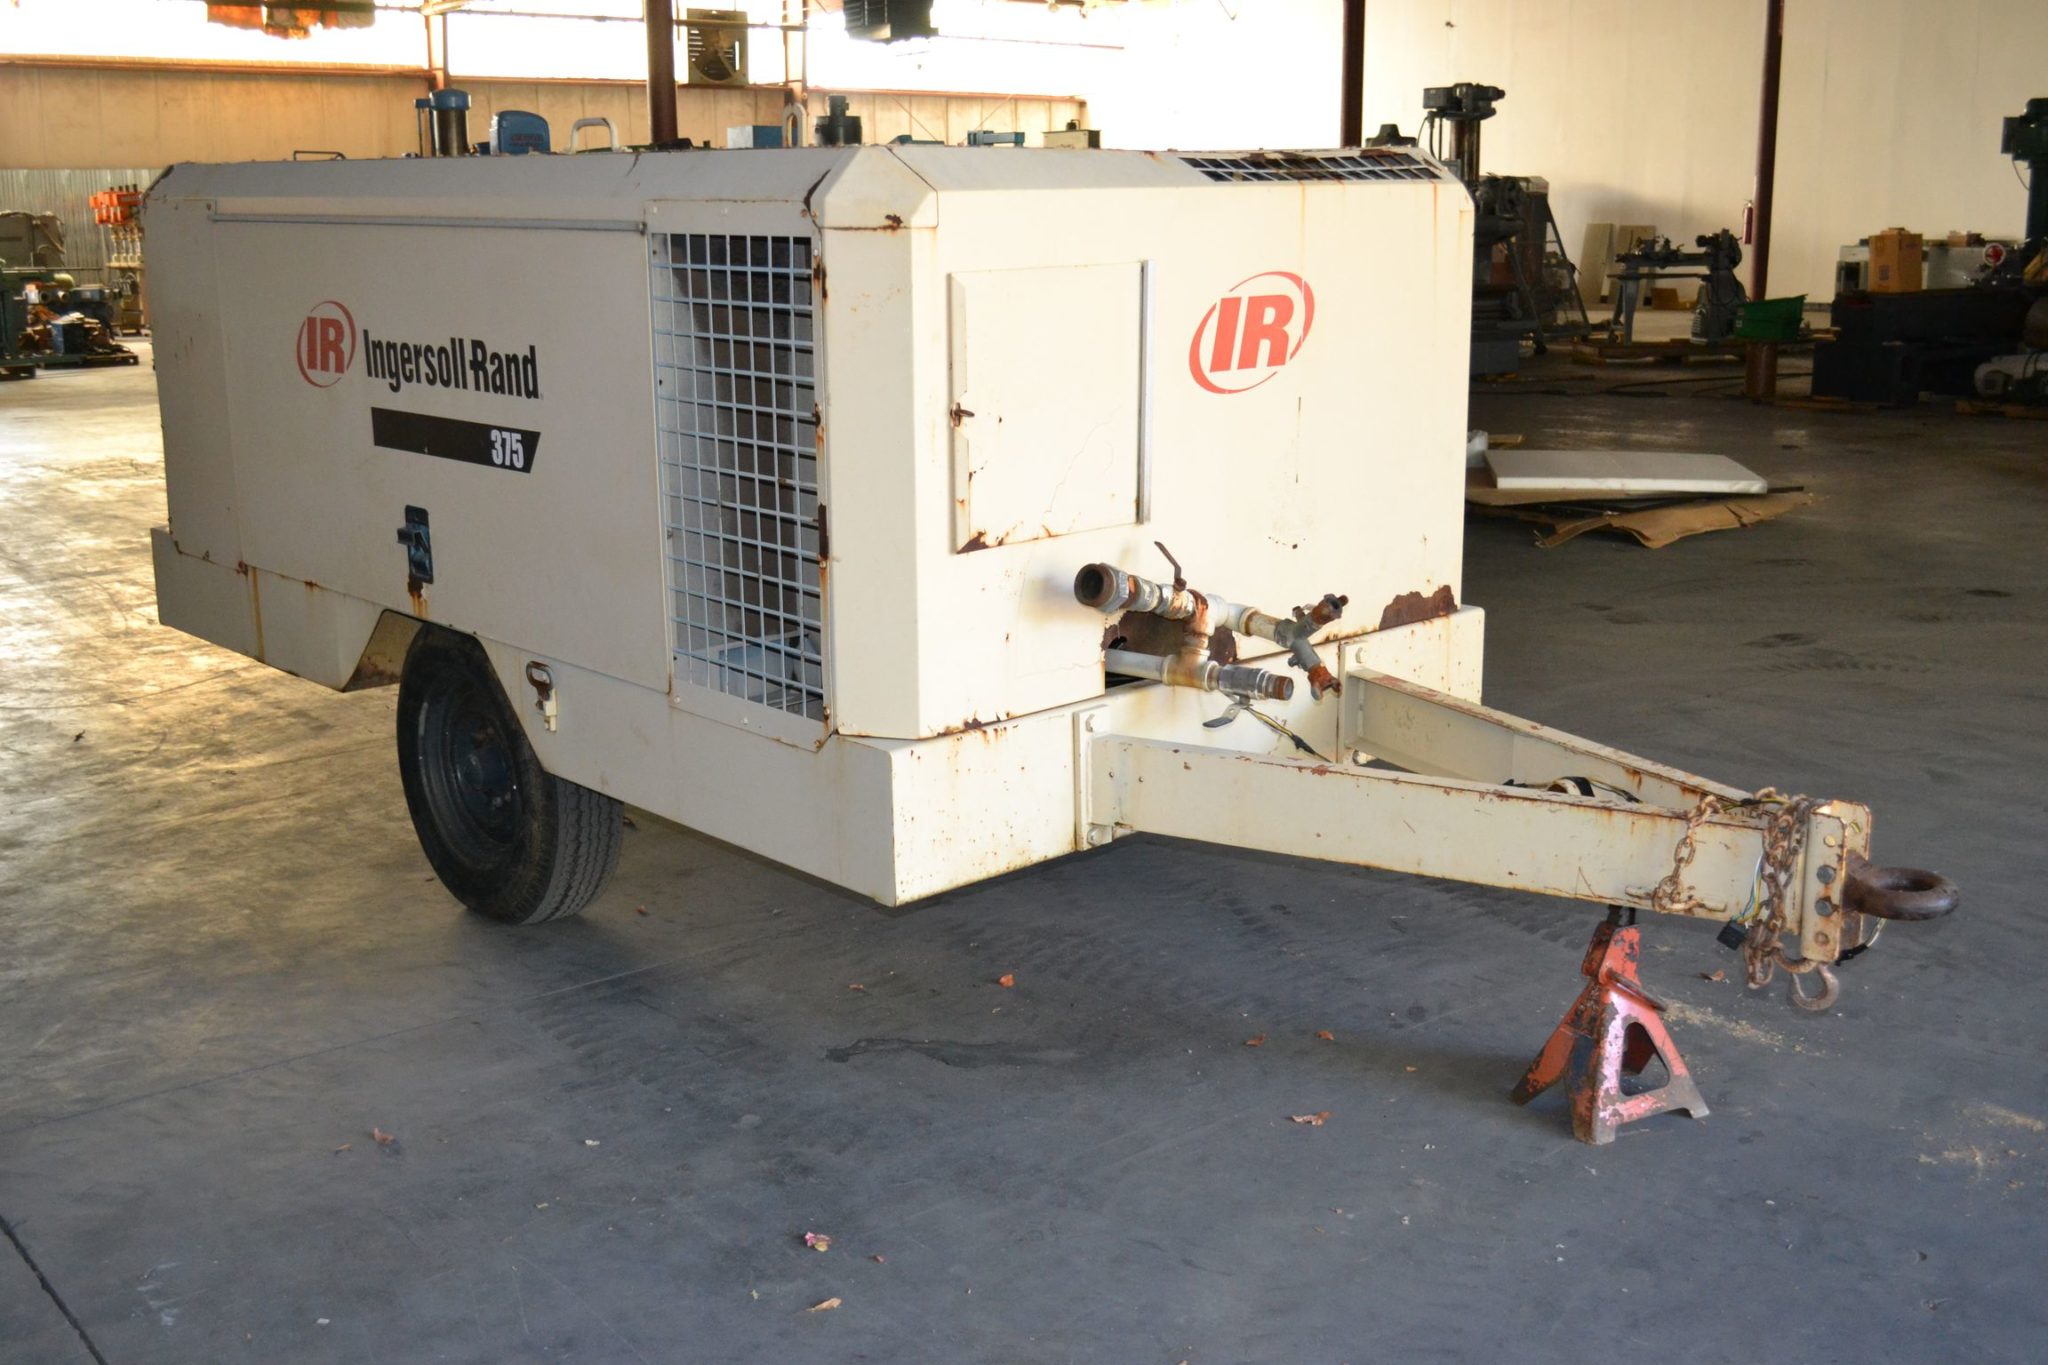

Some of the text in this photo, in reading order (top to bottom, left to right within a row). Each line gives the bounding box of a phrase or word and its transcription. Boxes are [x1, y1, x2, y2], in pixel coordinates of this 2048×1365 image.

[306, 316, 345, 374] IR
[1209, 294, 1294, 373] IR
[490, 429, 524, 469] 375
